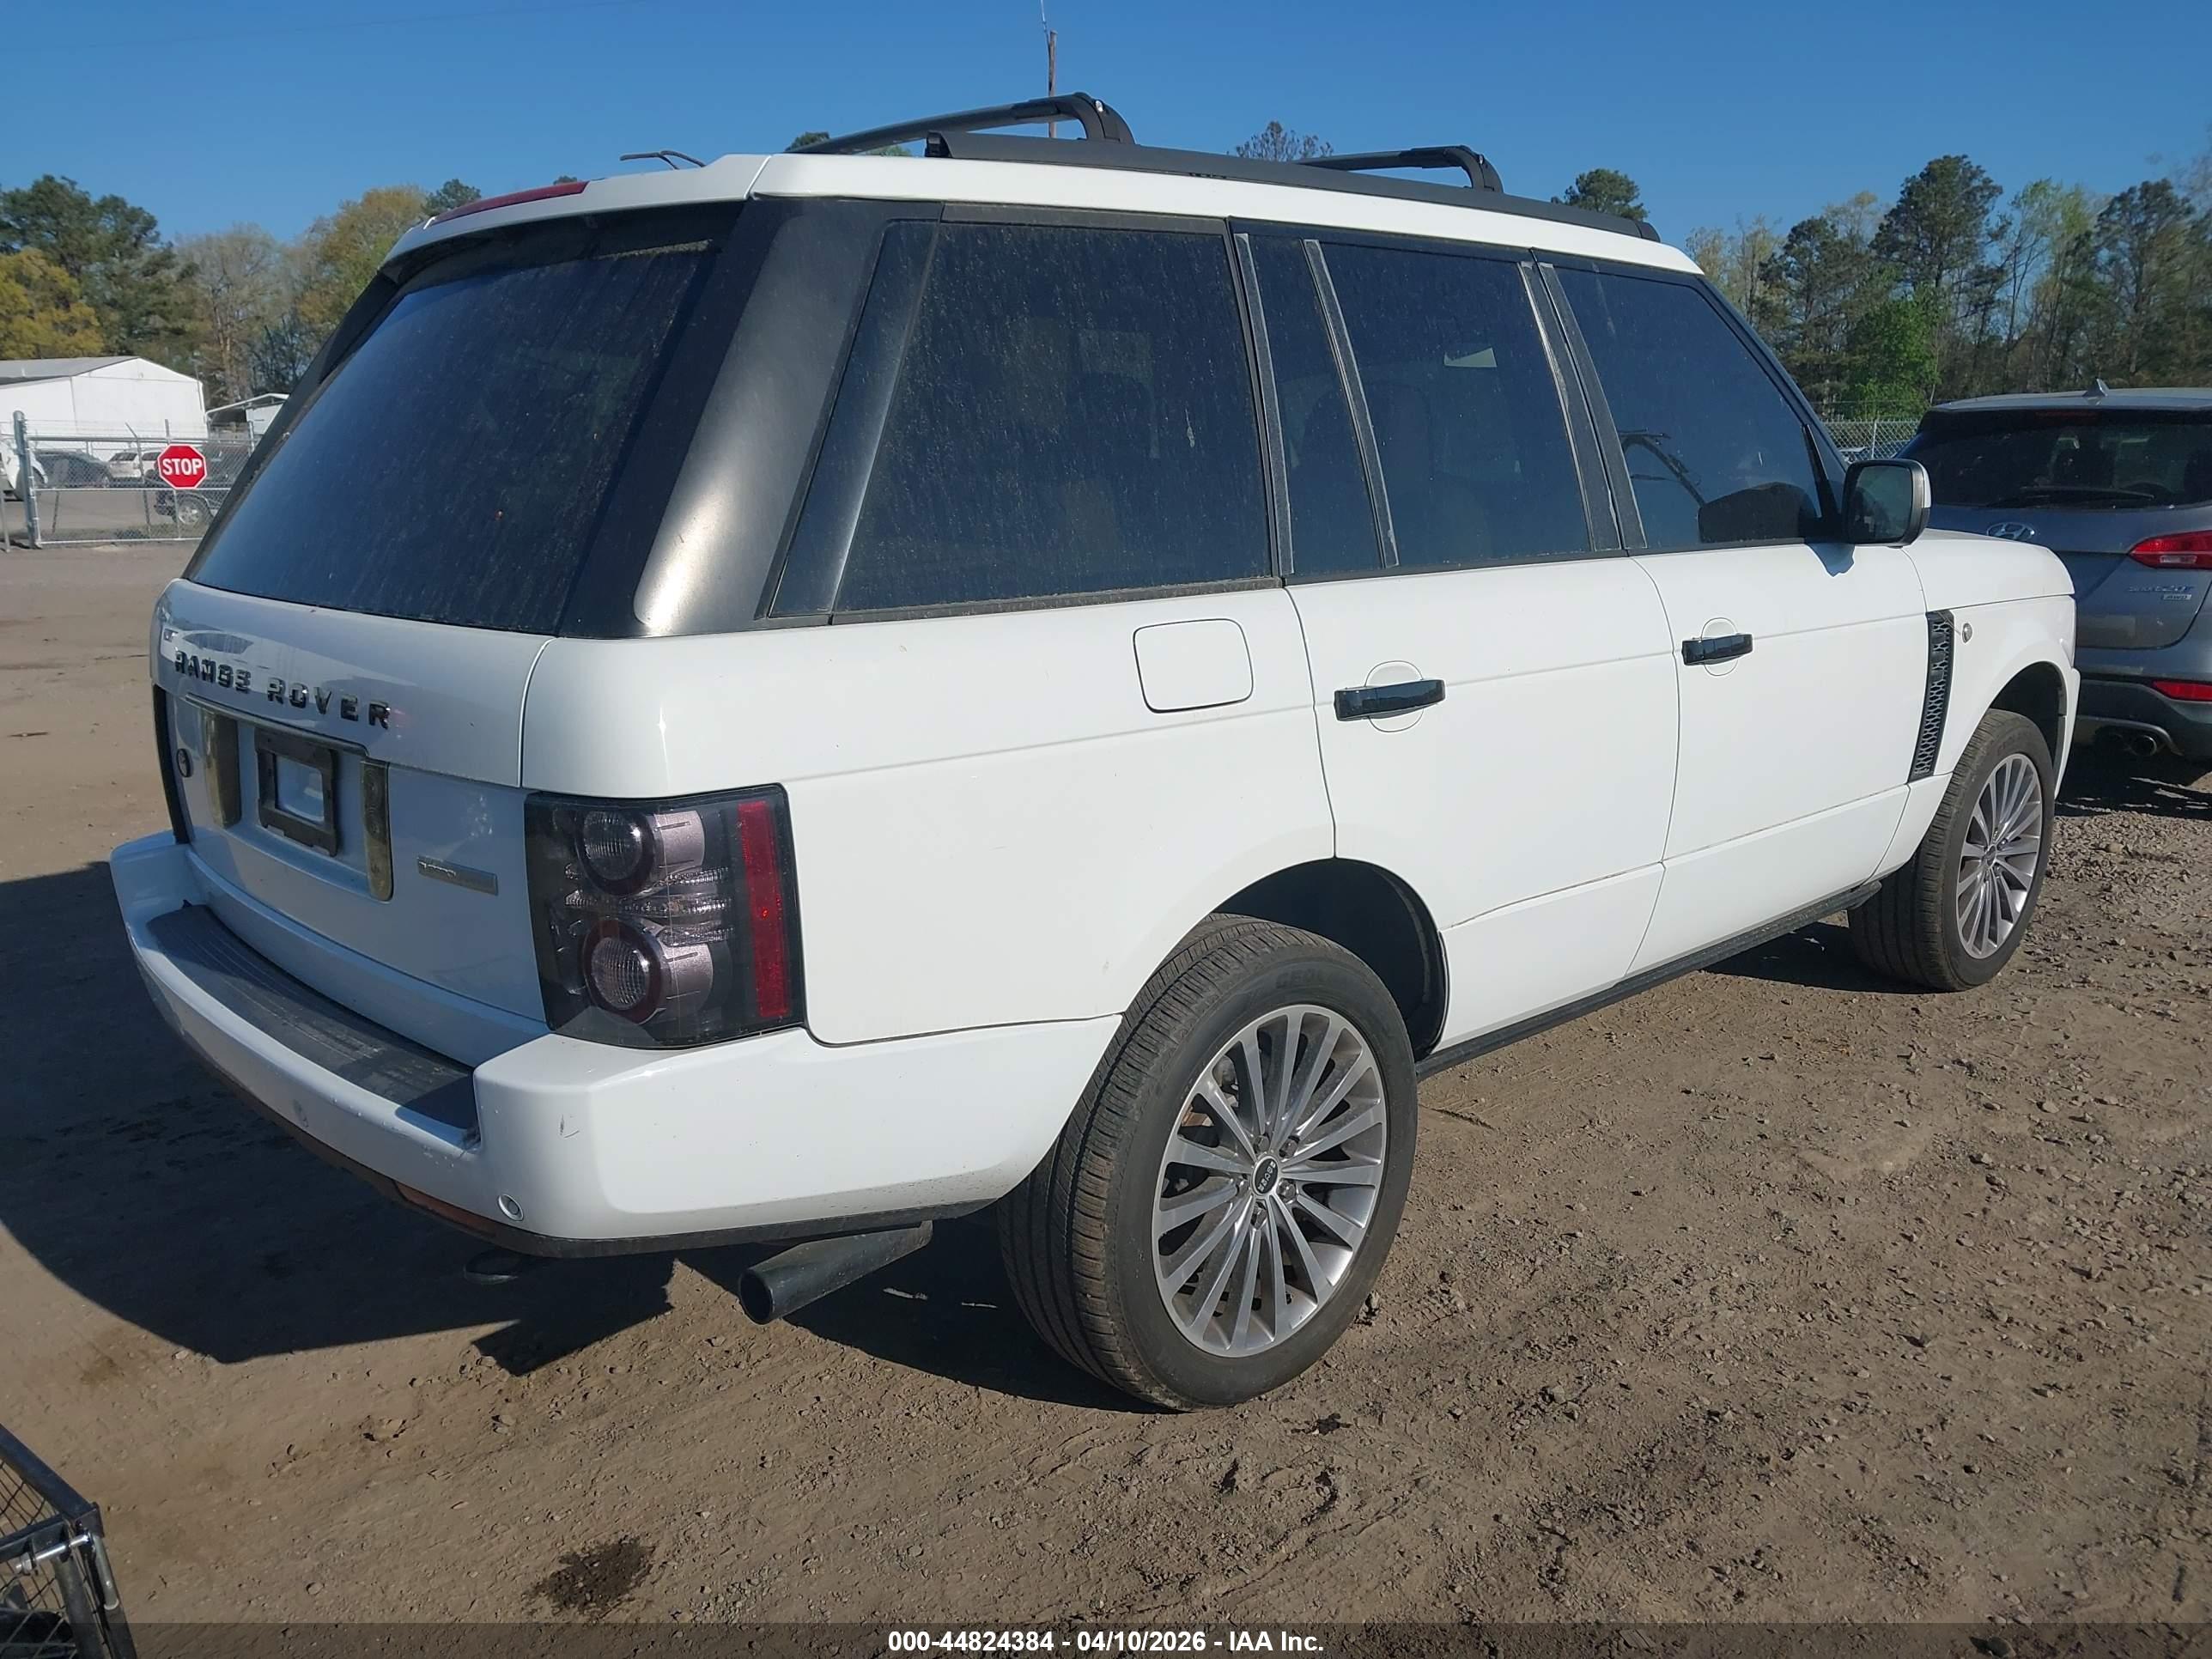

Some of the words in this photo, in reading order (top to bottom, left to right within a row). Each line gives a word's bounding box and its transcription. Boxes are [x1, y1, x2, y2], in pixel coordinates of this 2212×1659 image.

[162, 458, 203, 476] STOP
[174, 648, 252, 694] RANGE
[267, 677, 391, 730] ROVER
